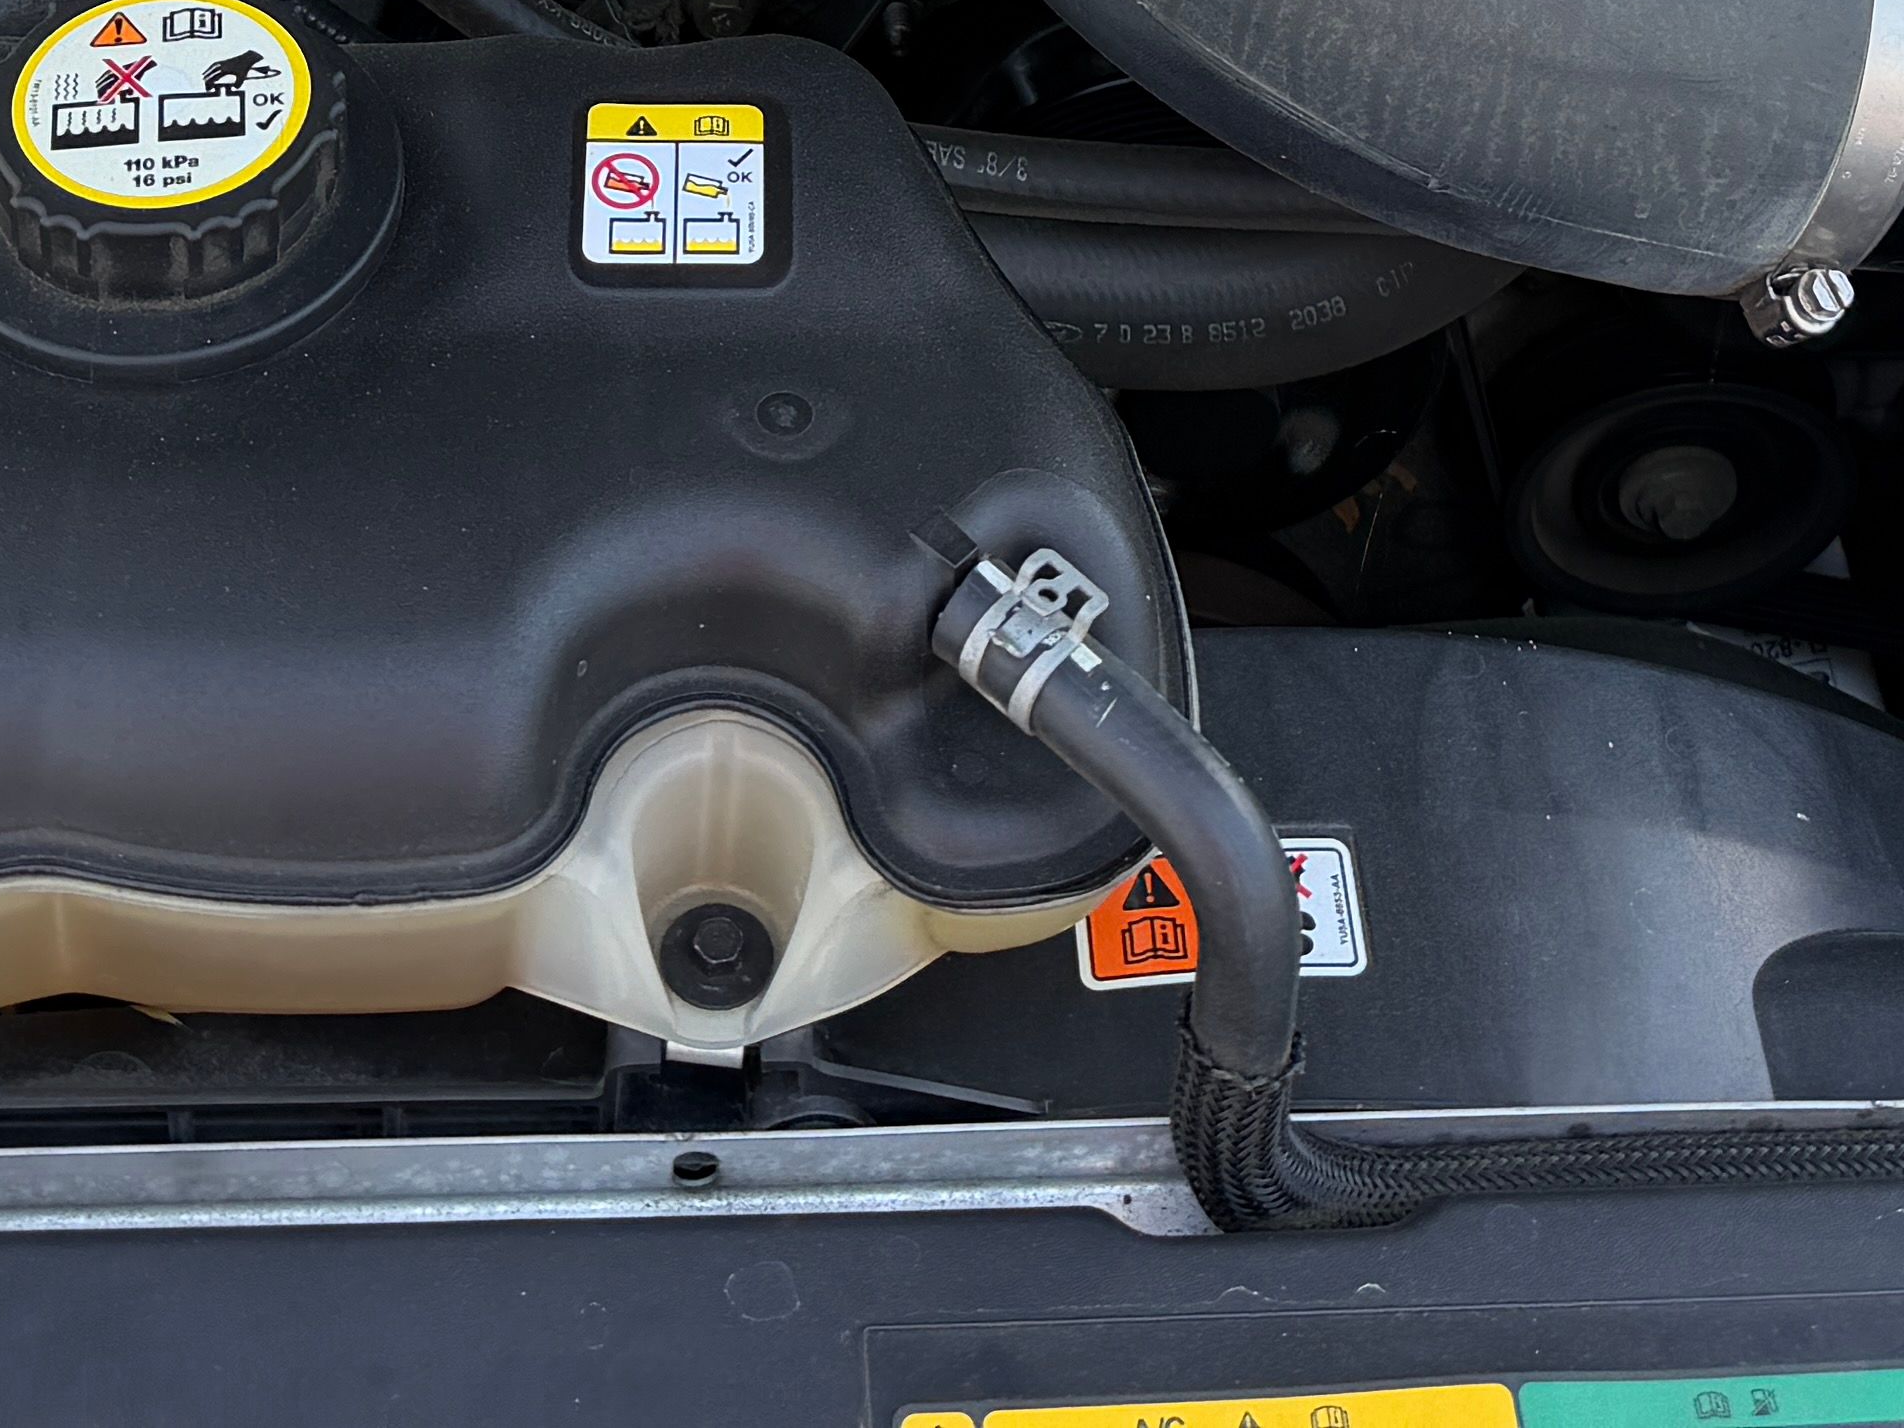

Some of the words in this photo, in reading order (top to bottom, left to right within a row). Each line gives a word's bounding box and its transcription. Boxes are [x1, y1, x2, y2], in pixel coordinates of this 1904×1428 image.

[252, 91, 286, 107] OK
[123, 157, 155, 172] 110
[161, 154, 200, 170] kPa
[132, 173, 156, 188] 16
[162, 171, 193, 188] psi
[726, 171, 754, 184] OK
